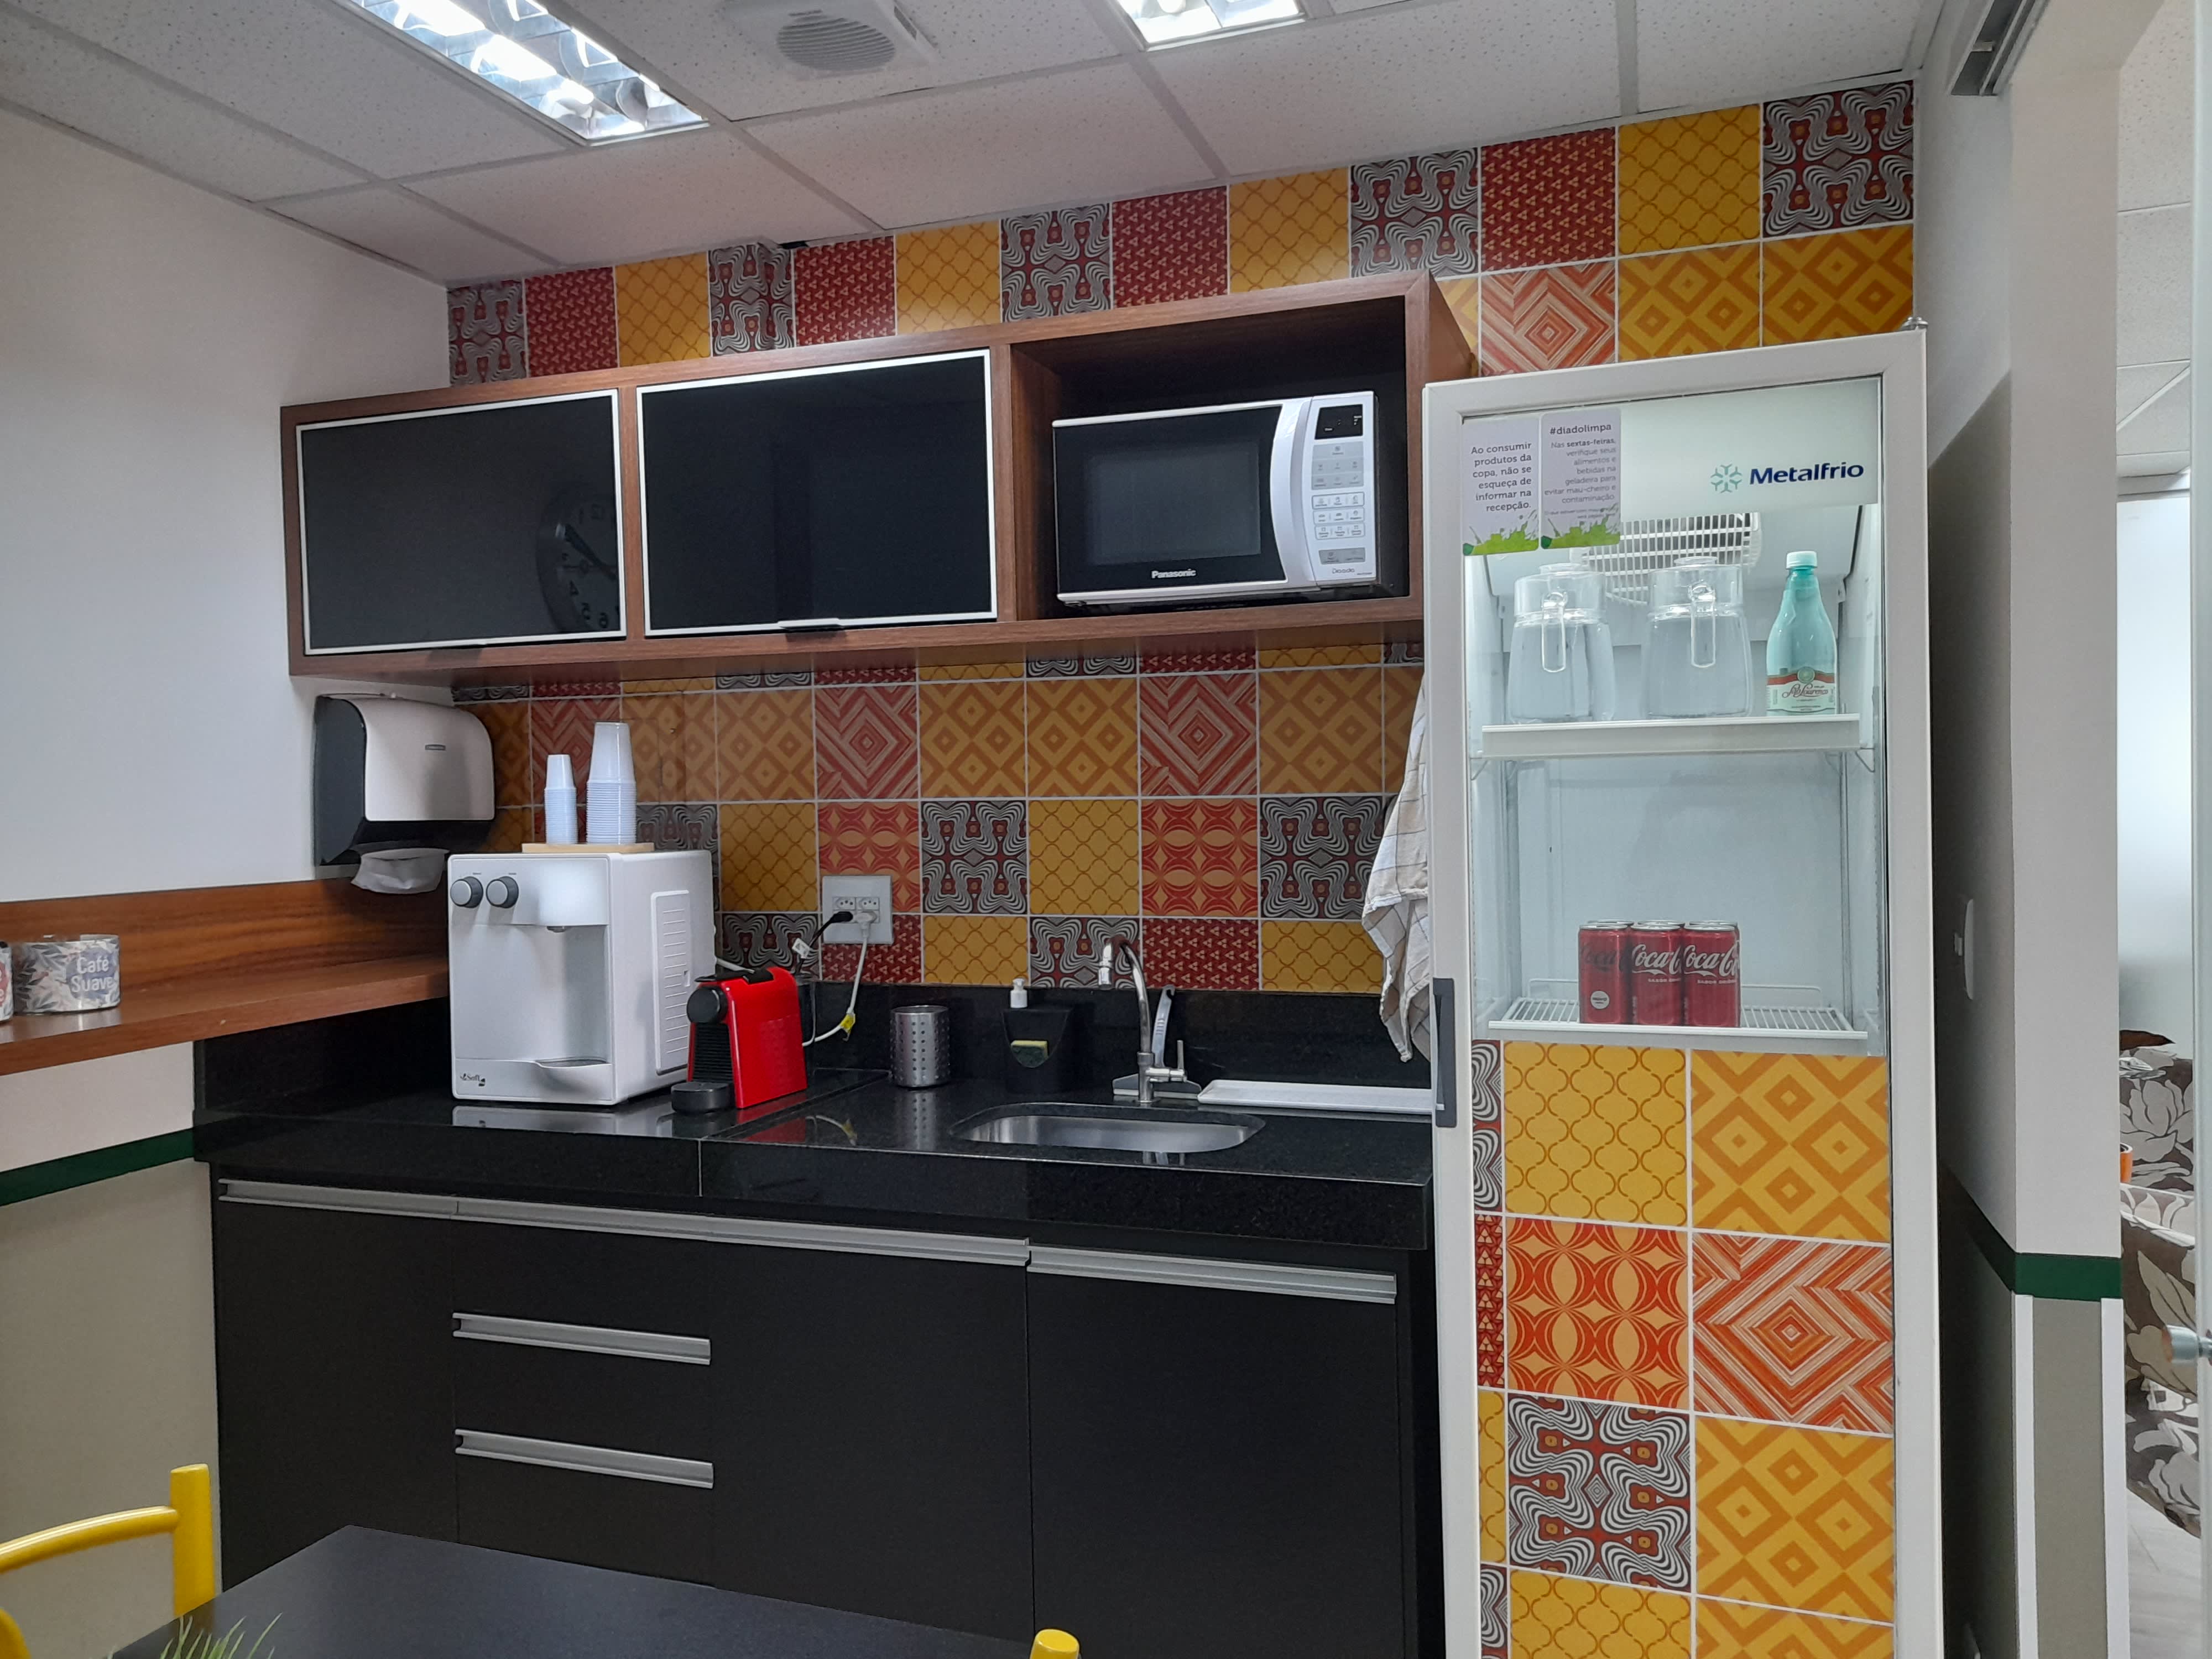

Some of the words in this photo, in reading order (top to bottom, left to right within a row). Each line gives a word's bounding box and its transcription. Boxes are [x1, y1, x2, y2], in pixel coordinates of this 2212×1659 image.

[1550, 424, 1611, 434] #diadolimpa
[1486, 442, 1531, 453] consumir
[1474, 456, 1517, 467] produtos
[1501, 467, 1519, 475] não
[1750, 462, 1864, 484] Metalfrio
[1478, 479, 1517, 489] esqueça
[1475, 492, 1517, 500] informar
[1486, 501, 1531, 512] recepção.
[1151, 568, 1196, 578] Panasonic
[76, 954, 109, 974] Café
[70, 975, 115, 993] Suave
